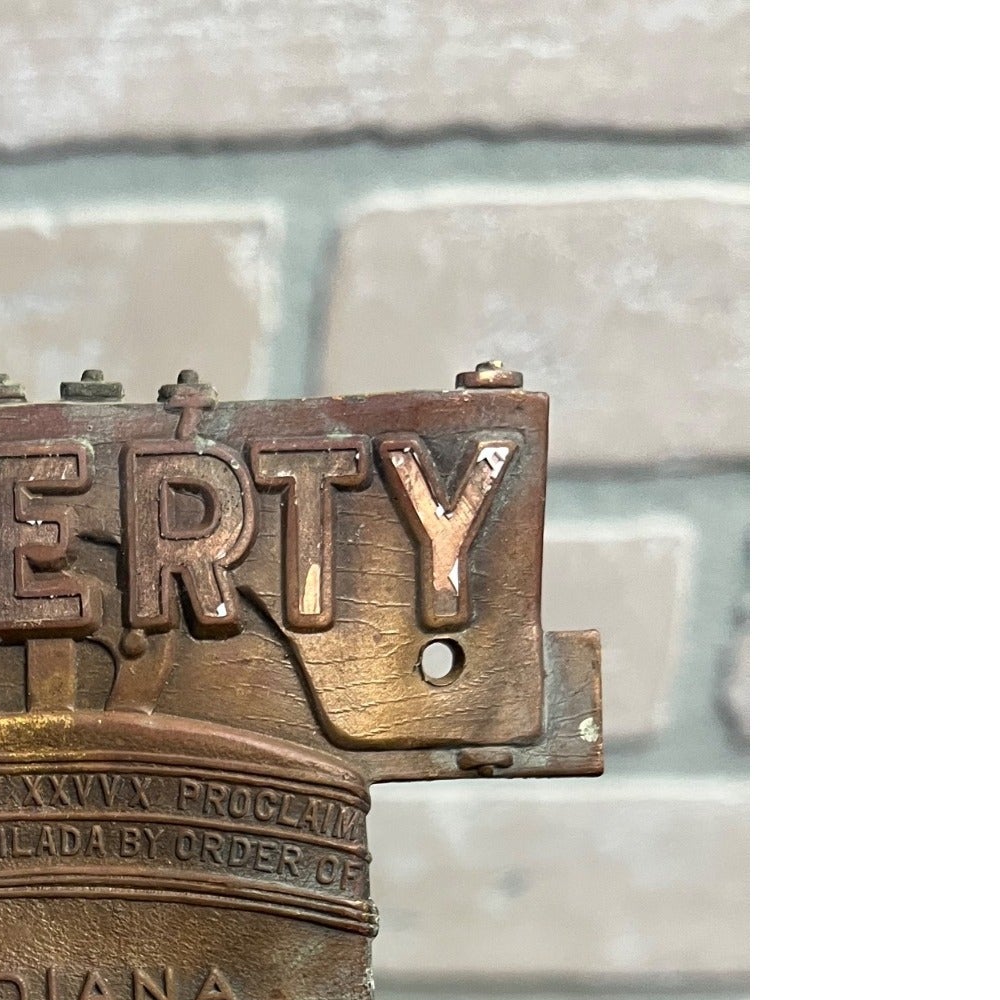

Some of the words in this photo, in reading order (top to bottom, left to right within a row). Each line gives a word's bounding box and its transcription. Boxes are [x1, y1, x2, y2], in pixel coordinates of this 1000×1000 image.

[177, 777, 361, 840] PROCLAIM
[119, 827, 165, 860] BY
[175, 829, 303, 877] ORDER
[316, 854, 361, 890] OF
